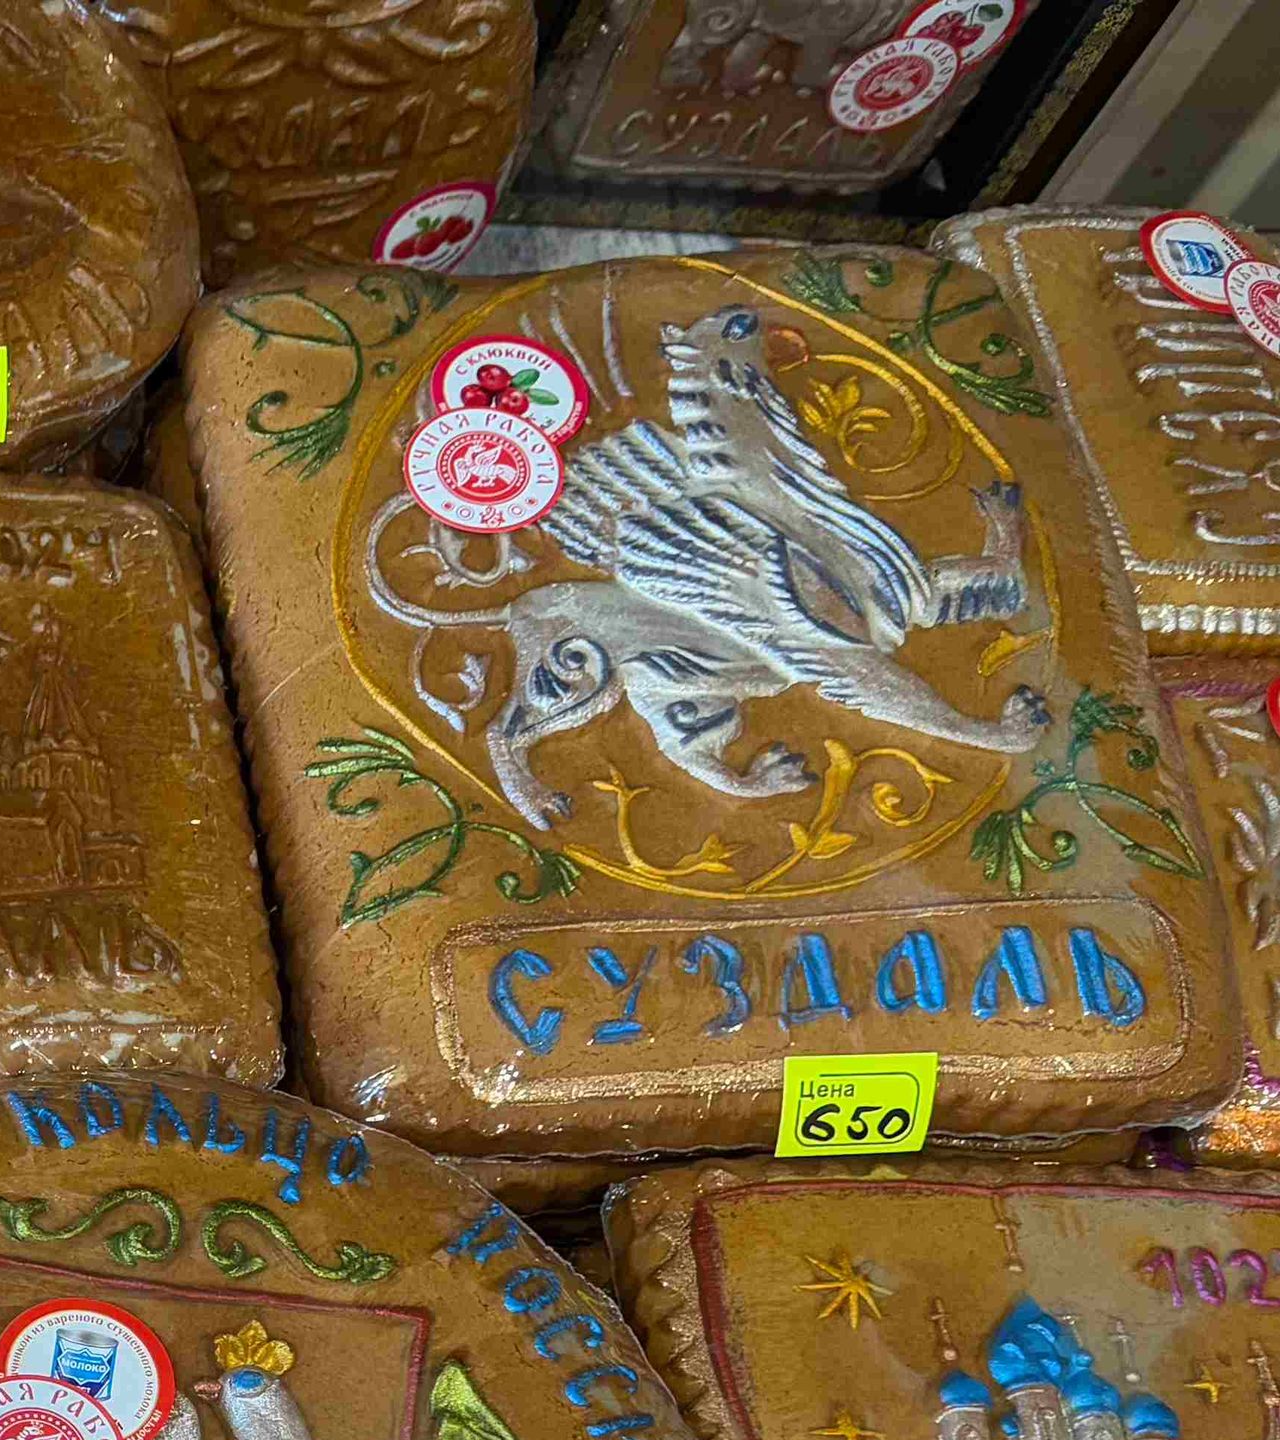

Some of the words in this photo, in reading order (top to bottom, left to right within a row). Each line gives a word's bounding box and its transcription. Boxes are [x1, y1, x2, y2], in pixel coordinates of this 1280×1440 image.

[488, 924, 1147, 1056] СУЗДАЛЬ
[800, 1080, 856, 1102] Цена
[6, 1082, 371, 1204] КОЛЬЦО
[798, 1104, 911, 1143] 650
[1142, 1246, 1280, 1309] 102
[61, 1358, 108, 1374] МОЛОКО
